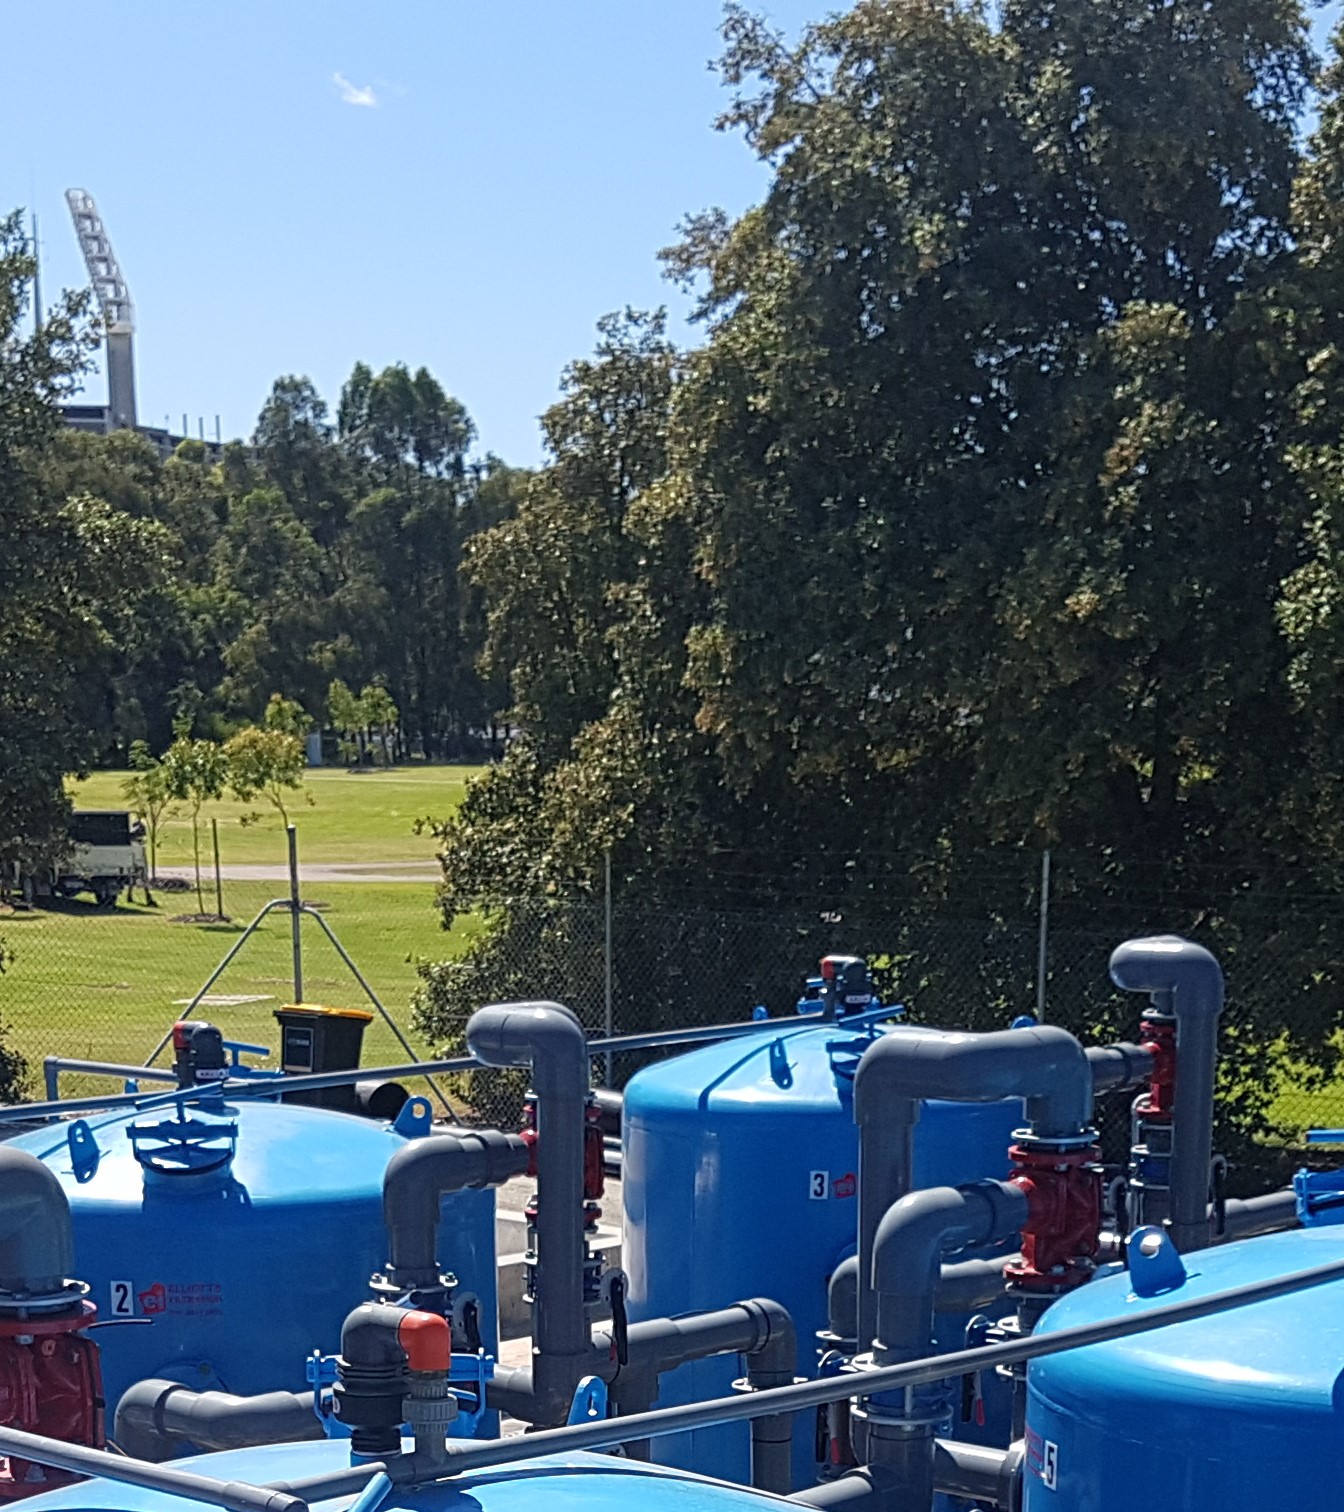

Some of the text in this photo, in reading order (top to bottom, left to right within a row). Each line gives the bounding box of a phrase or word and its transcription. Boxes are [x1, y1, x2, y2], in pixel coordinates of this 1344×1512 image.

[813, 1173, 825, 1198] 3
[115, 1283, 130, 1313] 2
[1047, 1445, 1055, 1486] 5
